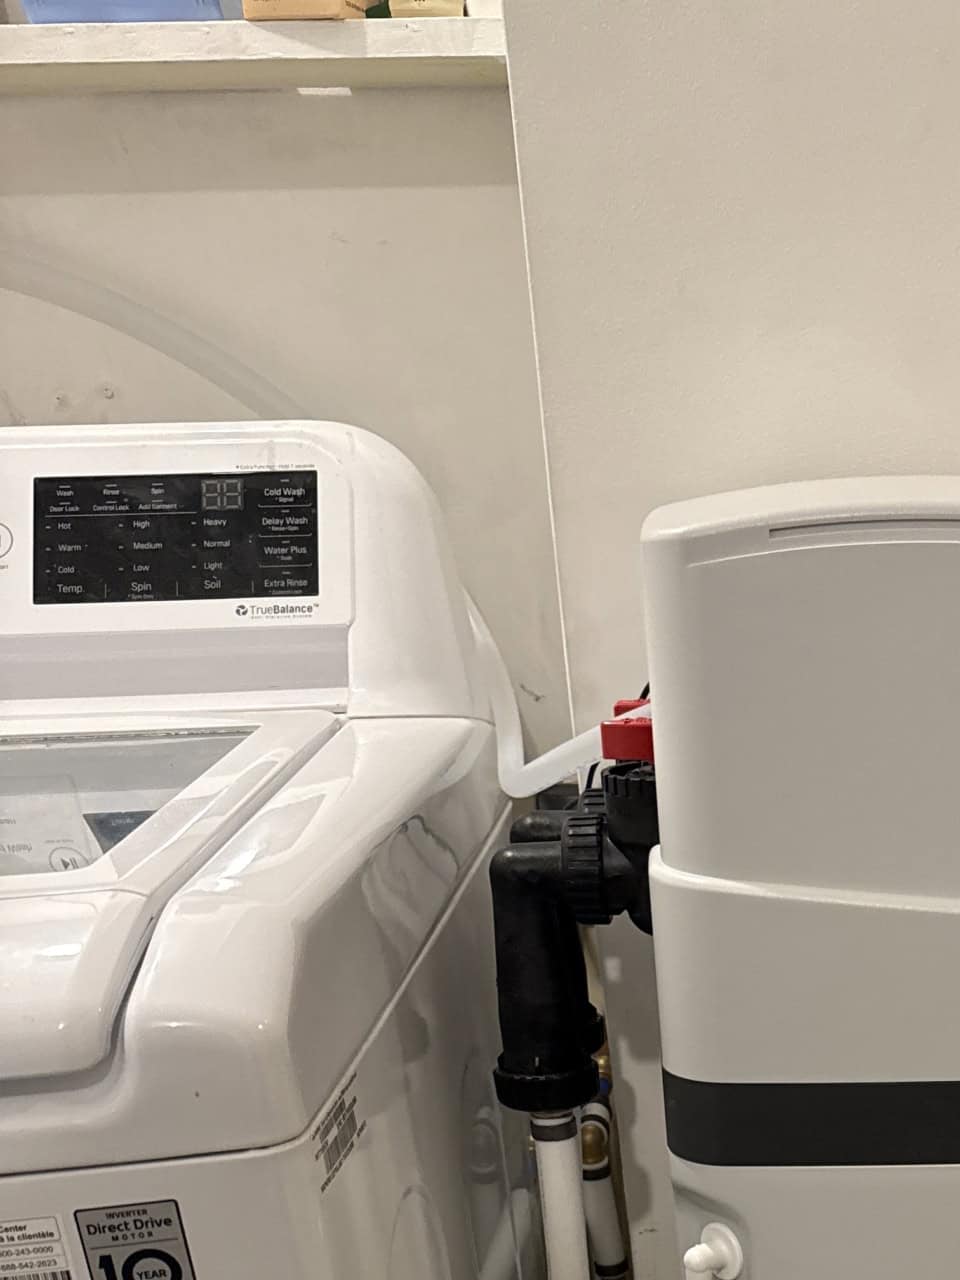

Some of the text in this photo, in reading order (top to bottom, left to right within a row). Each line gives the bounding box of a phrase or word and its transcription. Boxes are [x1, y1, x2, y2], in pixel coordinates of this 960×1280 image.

[264, 487, 306, 497] Cold Wash
[133, 520, 151, 530] High
[203, 518, 227, 527] Heavy
[262, 516, 309, 526] Delay Wash
[58, 544, 82, 552] Warm
[133, 542, 163, 550] Medium
[203, 540, 231, 548] Normal
[264, 545, 307, 555] Water Plus
[57, 566, 75, 574] Cold
[133, 564, 150, 572] Low
[203, 561, 223, 571] Light
[131, 582, 152, 592] Spin
[204, 579, 221, 589] Soil
[264, 579, 308, 588] Extra Rinse
[105, 1209, 148, 1219] INVERTER
[86, 1217, 172, 1236] Direct Drive
[6, 1234, 15, 1242] la
[17, 1230, 55, 1241] clientèle
[112, 1231, 154, 1241] MOTOR
[136, 1269, 168, 1280] YEAR
